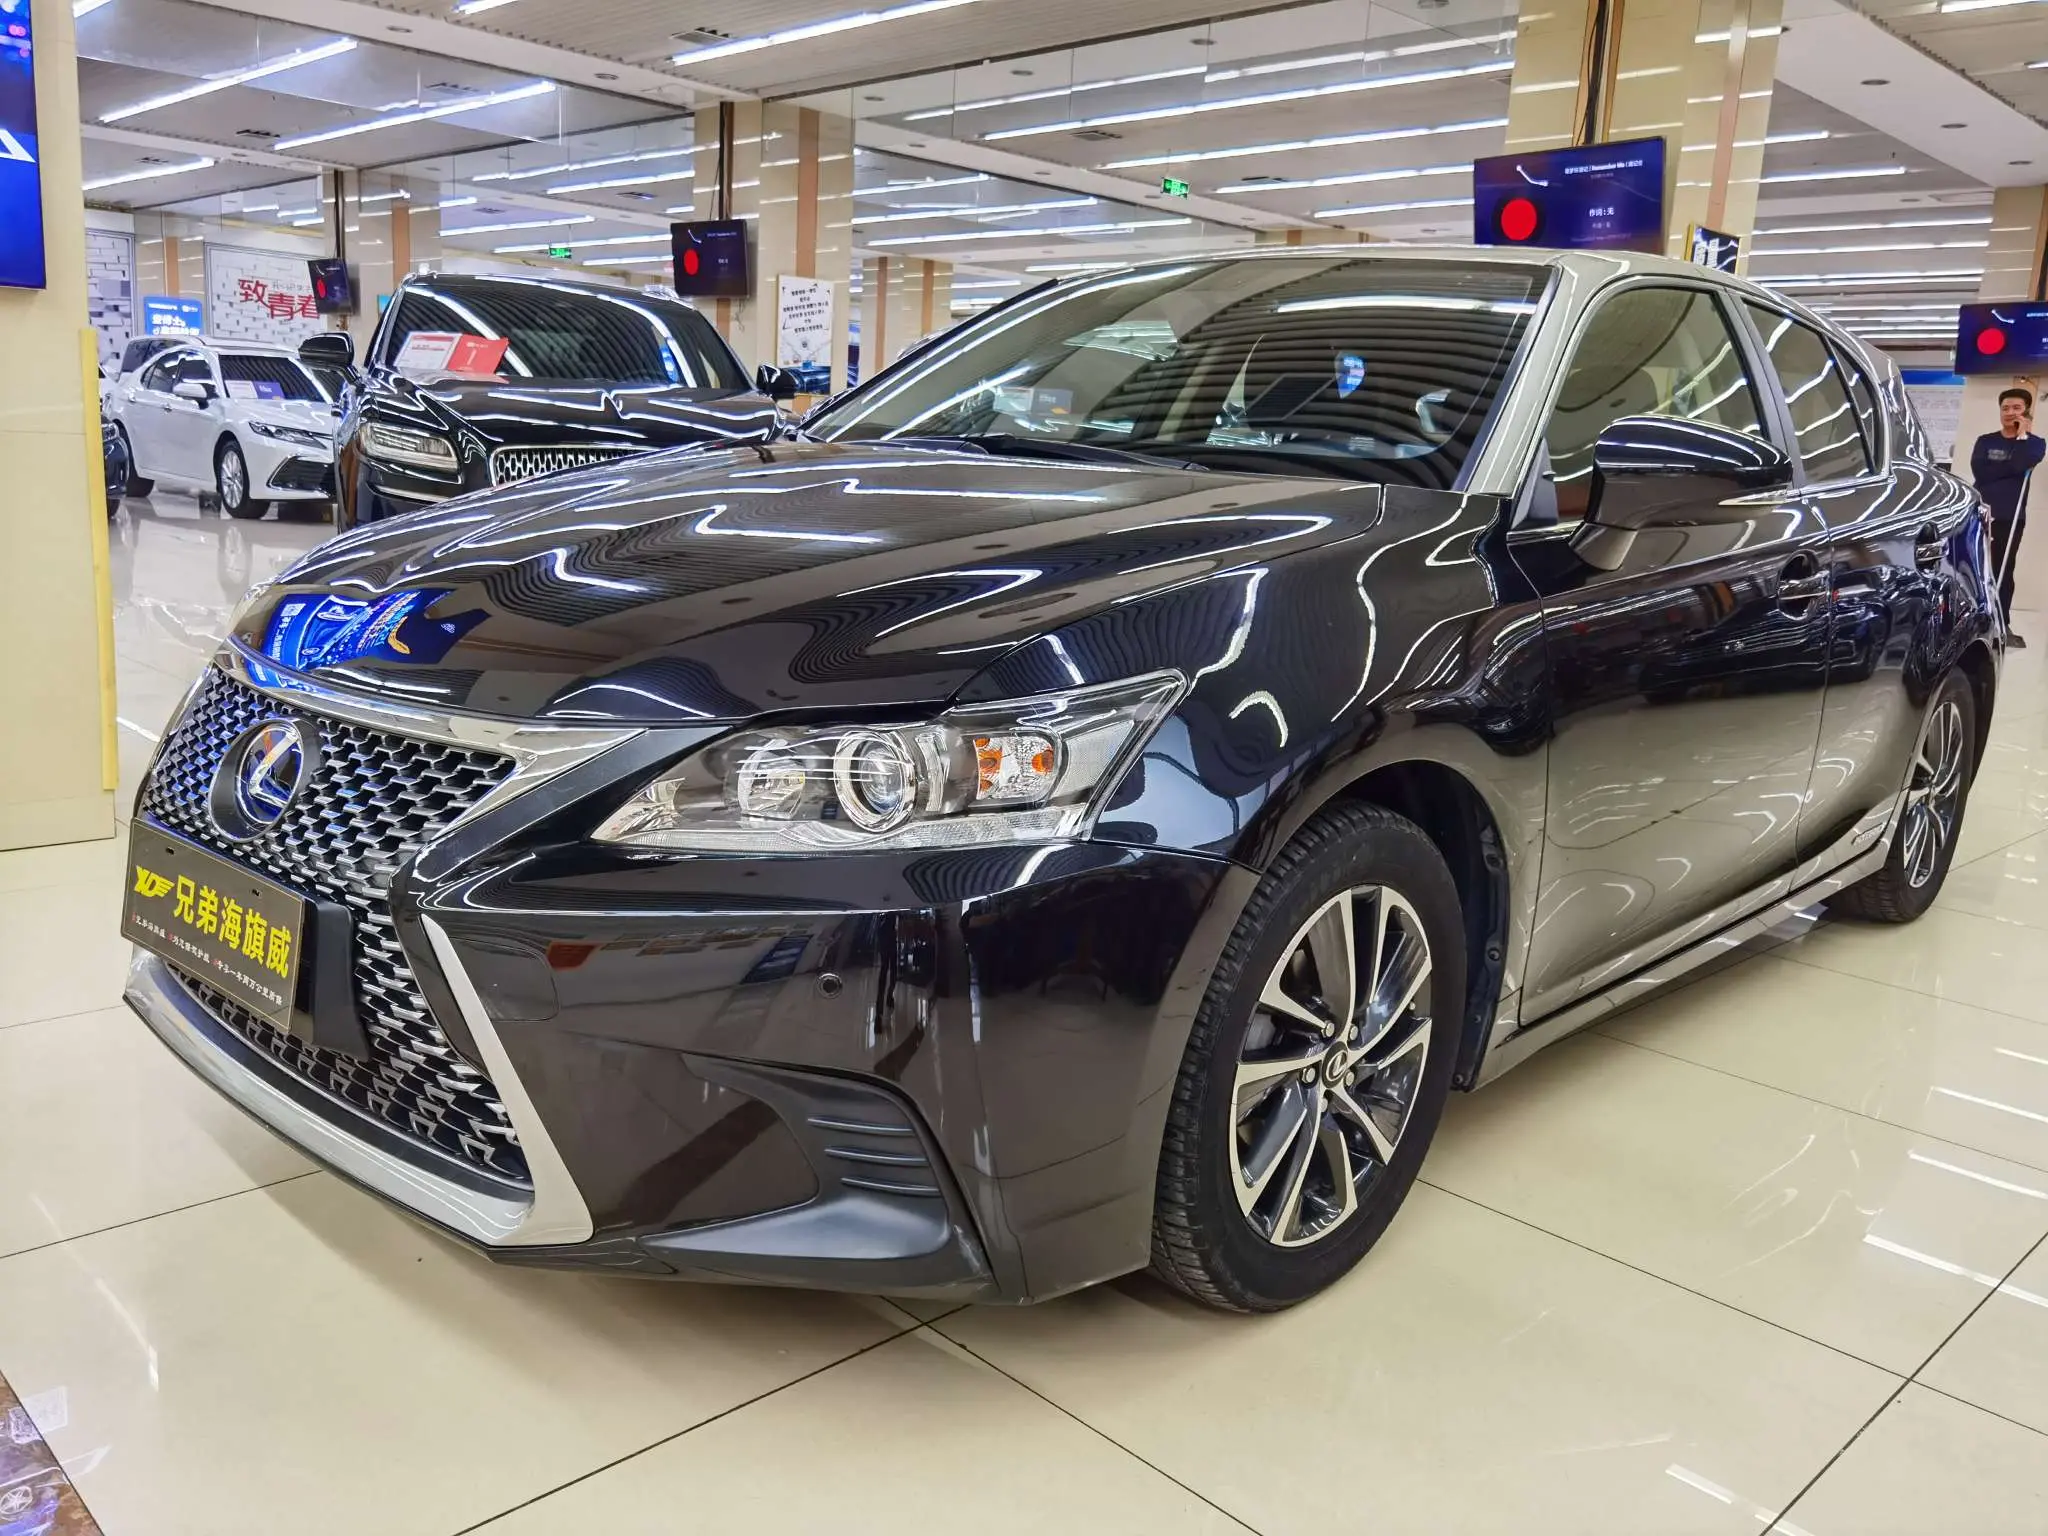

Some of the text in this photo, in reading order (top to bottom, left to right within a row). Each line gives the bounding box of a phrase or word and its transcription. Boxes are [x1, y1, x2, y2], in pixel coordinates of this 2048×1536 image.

[173, 874, 292, 978] 兄弟海旗威
